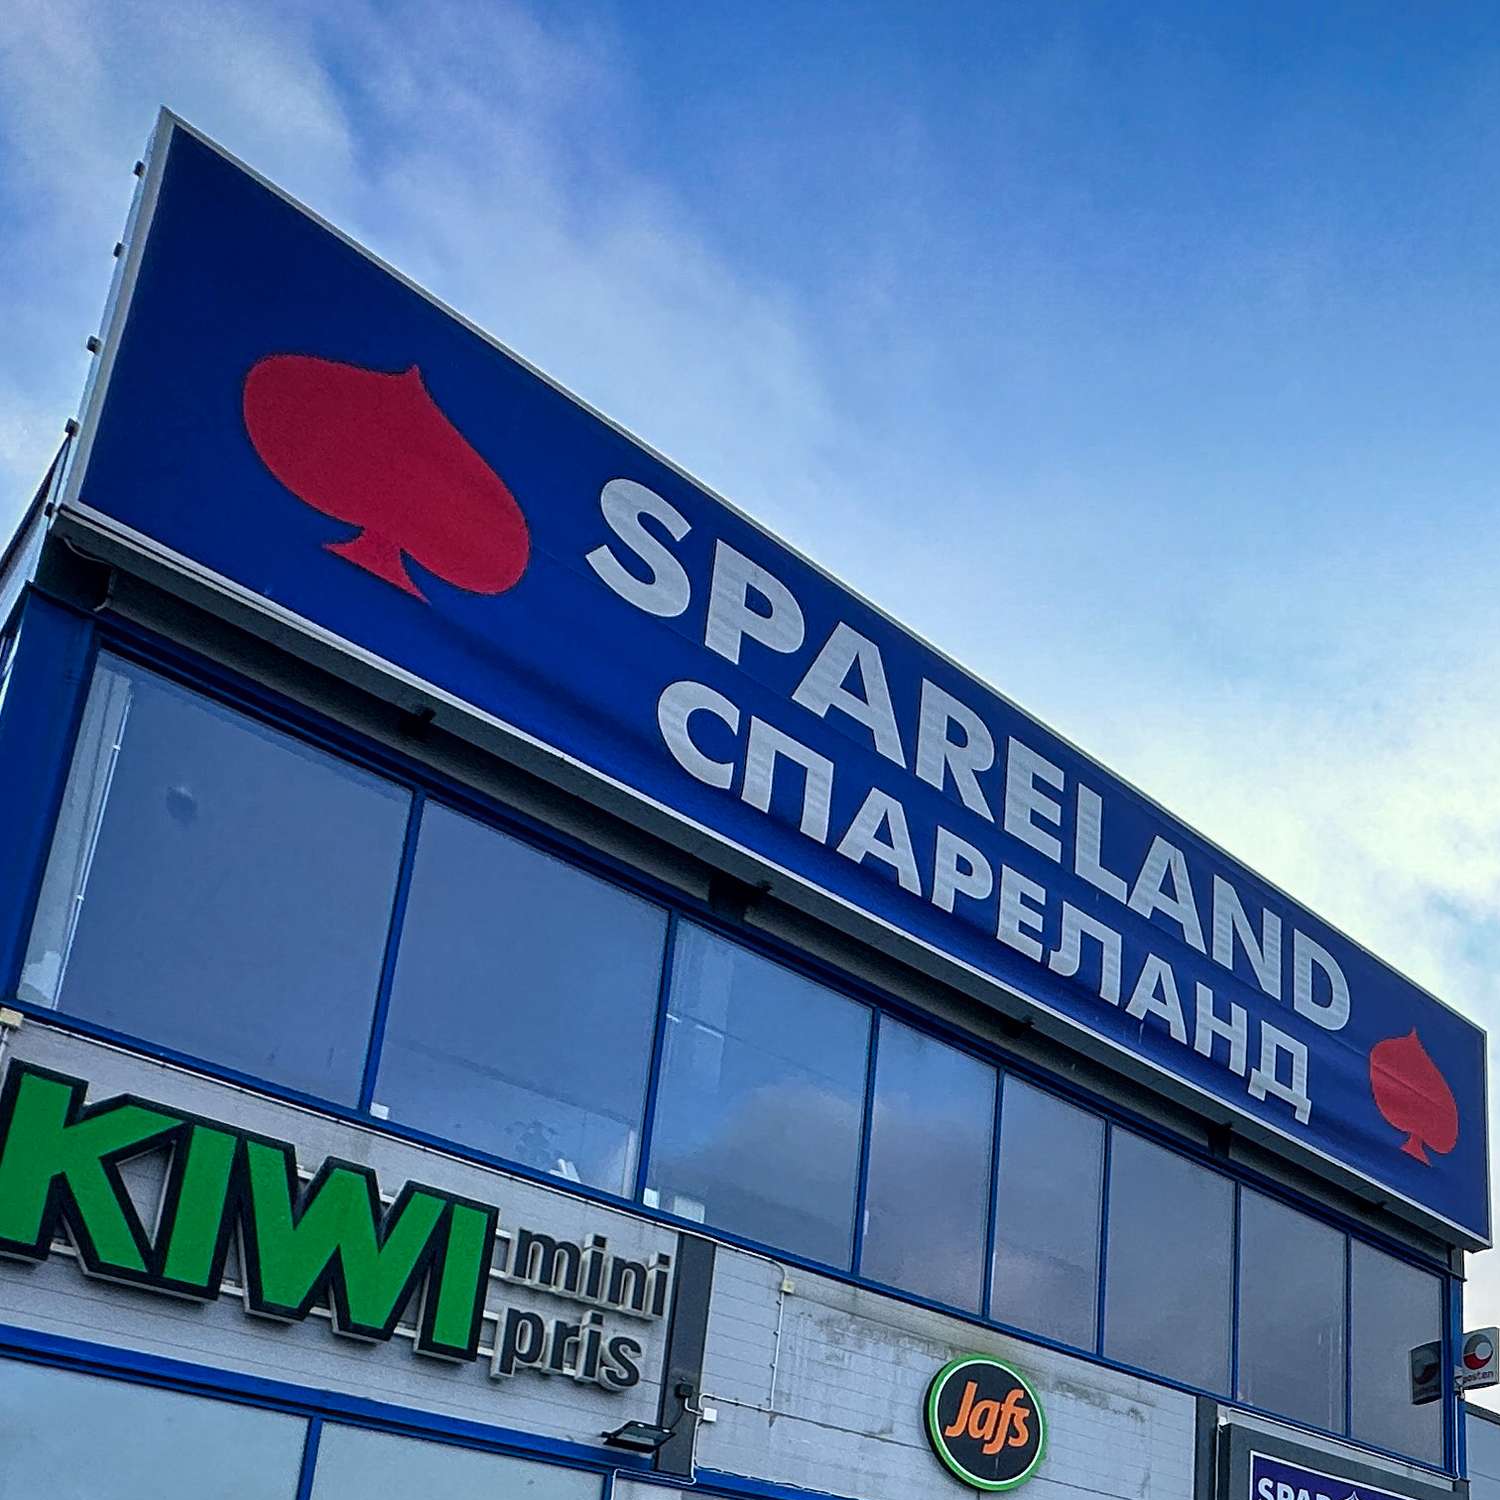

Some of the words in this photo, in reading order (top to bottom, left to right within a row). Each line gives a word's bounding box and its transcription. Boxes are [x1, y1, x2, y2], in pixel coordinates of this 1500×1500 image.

[586, 478, 1351, 1032] SPARELAND
[657, 680, 1311, 1125] СПАРЕЛАНД
[0, 1058, 499, 1362] KIWI
[511, 1225, 673, 1319] mini
[491, 1304, 643, 1393] pris
[944, 1381, 1031, 1455] Jafs
